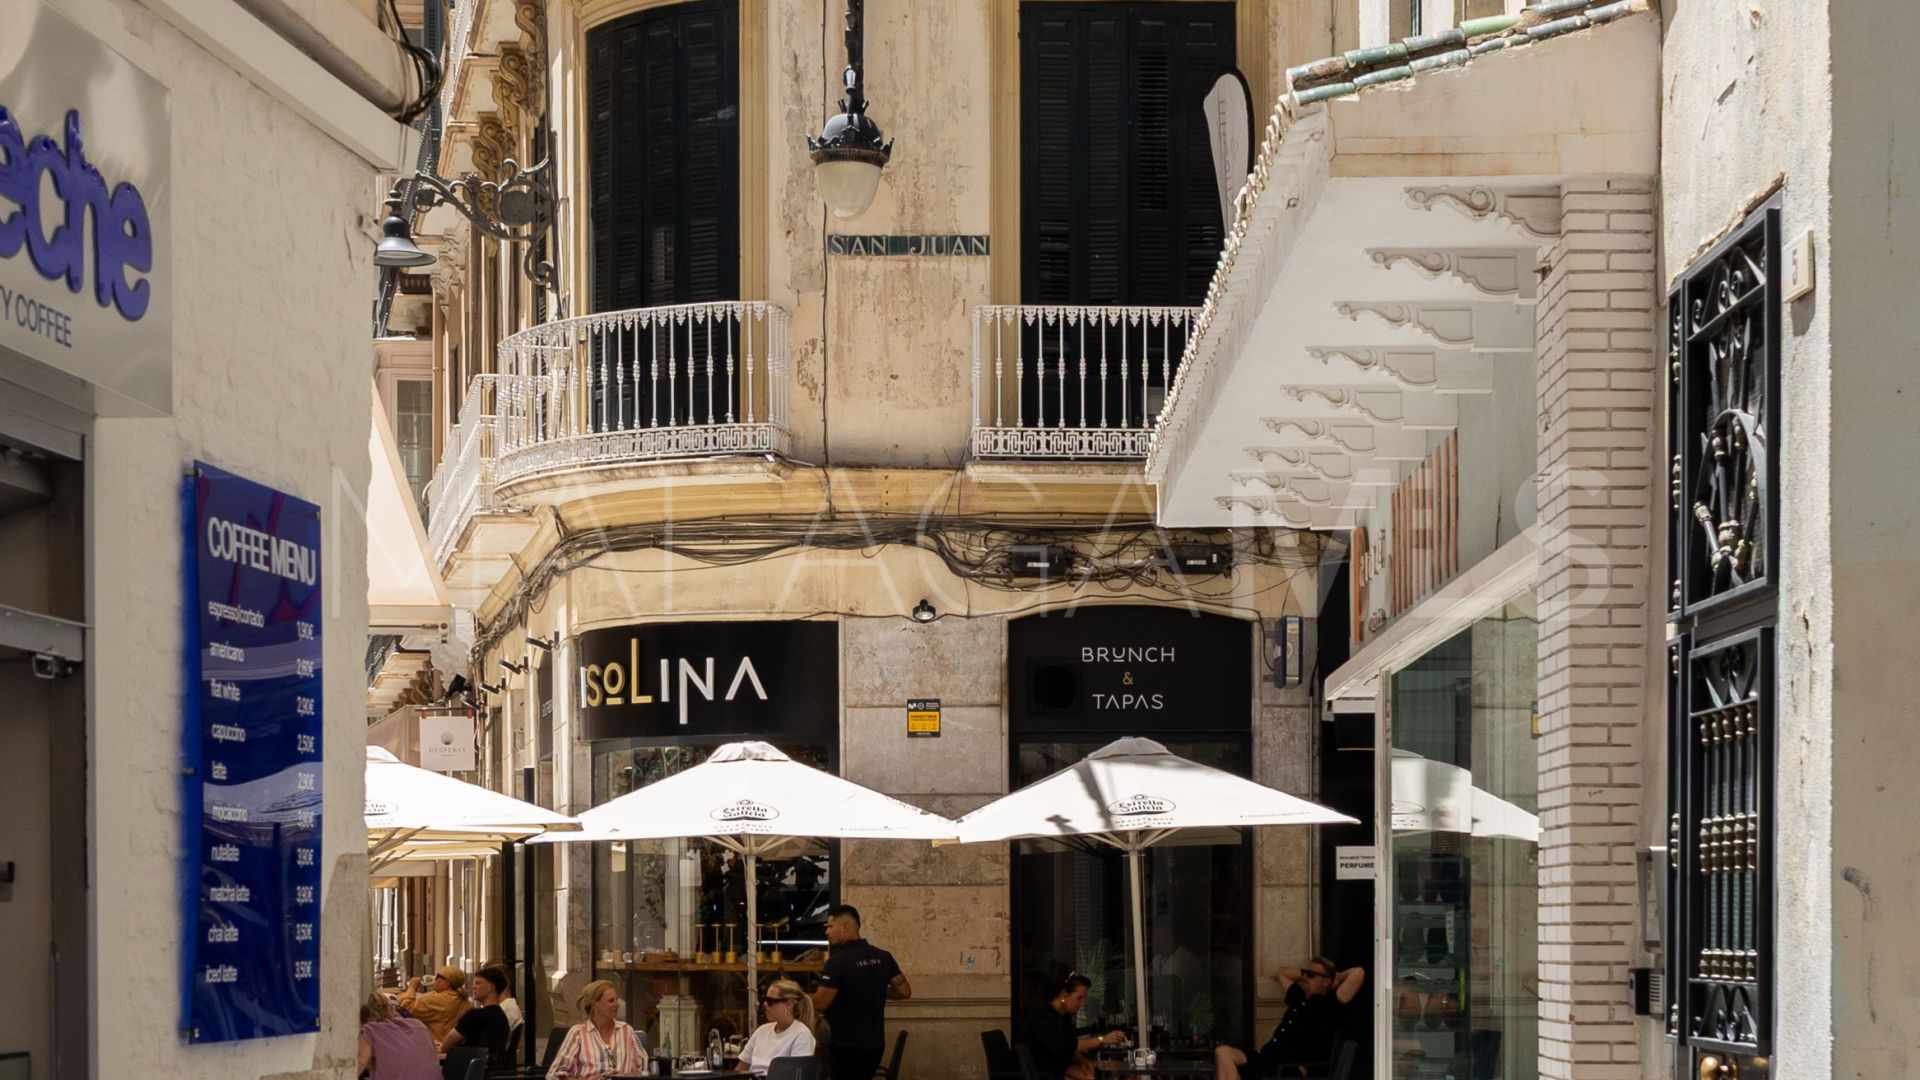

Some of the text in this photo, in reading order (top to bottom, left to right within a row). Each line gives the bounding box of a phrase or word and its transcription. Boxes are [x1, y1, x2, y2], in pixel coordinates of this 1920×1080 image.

[831, 234, 988, 256] SAN JUAN
[0, 284, 72, 349] Y COFFEE
[207, 517, 316, 586] COFFEE MENU
[209, 641, 244, 662] americano
[1082, 647, 1175, 662] BRUNCH
[1123, 672, 1133, 685] &
[223, 682, 240, 701] white
[1092, 694, 1164, 709] TAPAS
[212, 760, 227, 780] latte
[209, 884, 250, 902] matcha latte
[208, 923, 239, 942] chai latte
[205, 965, 237, 982] iced latte
